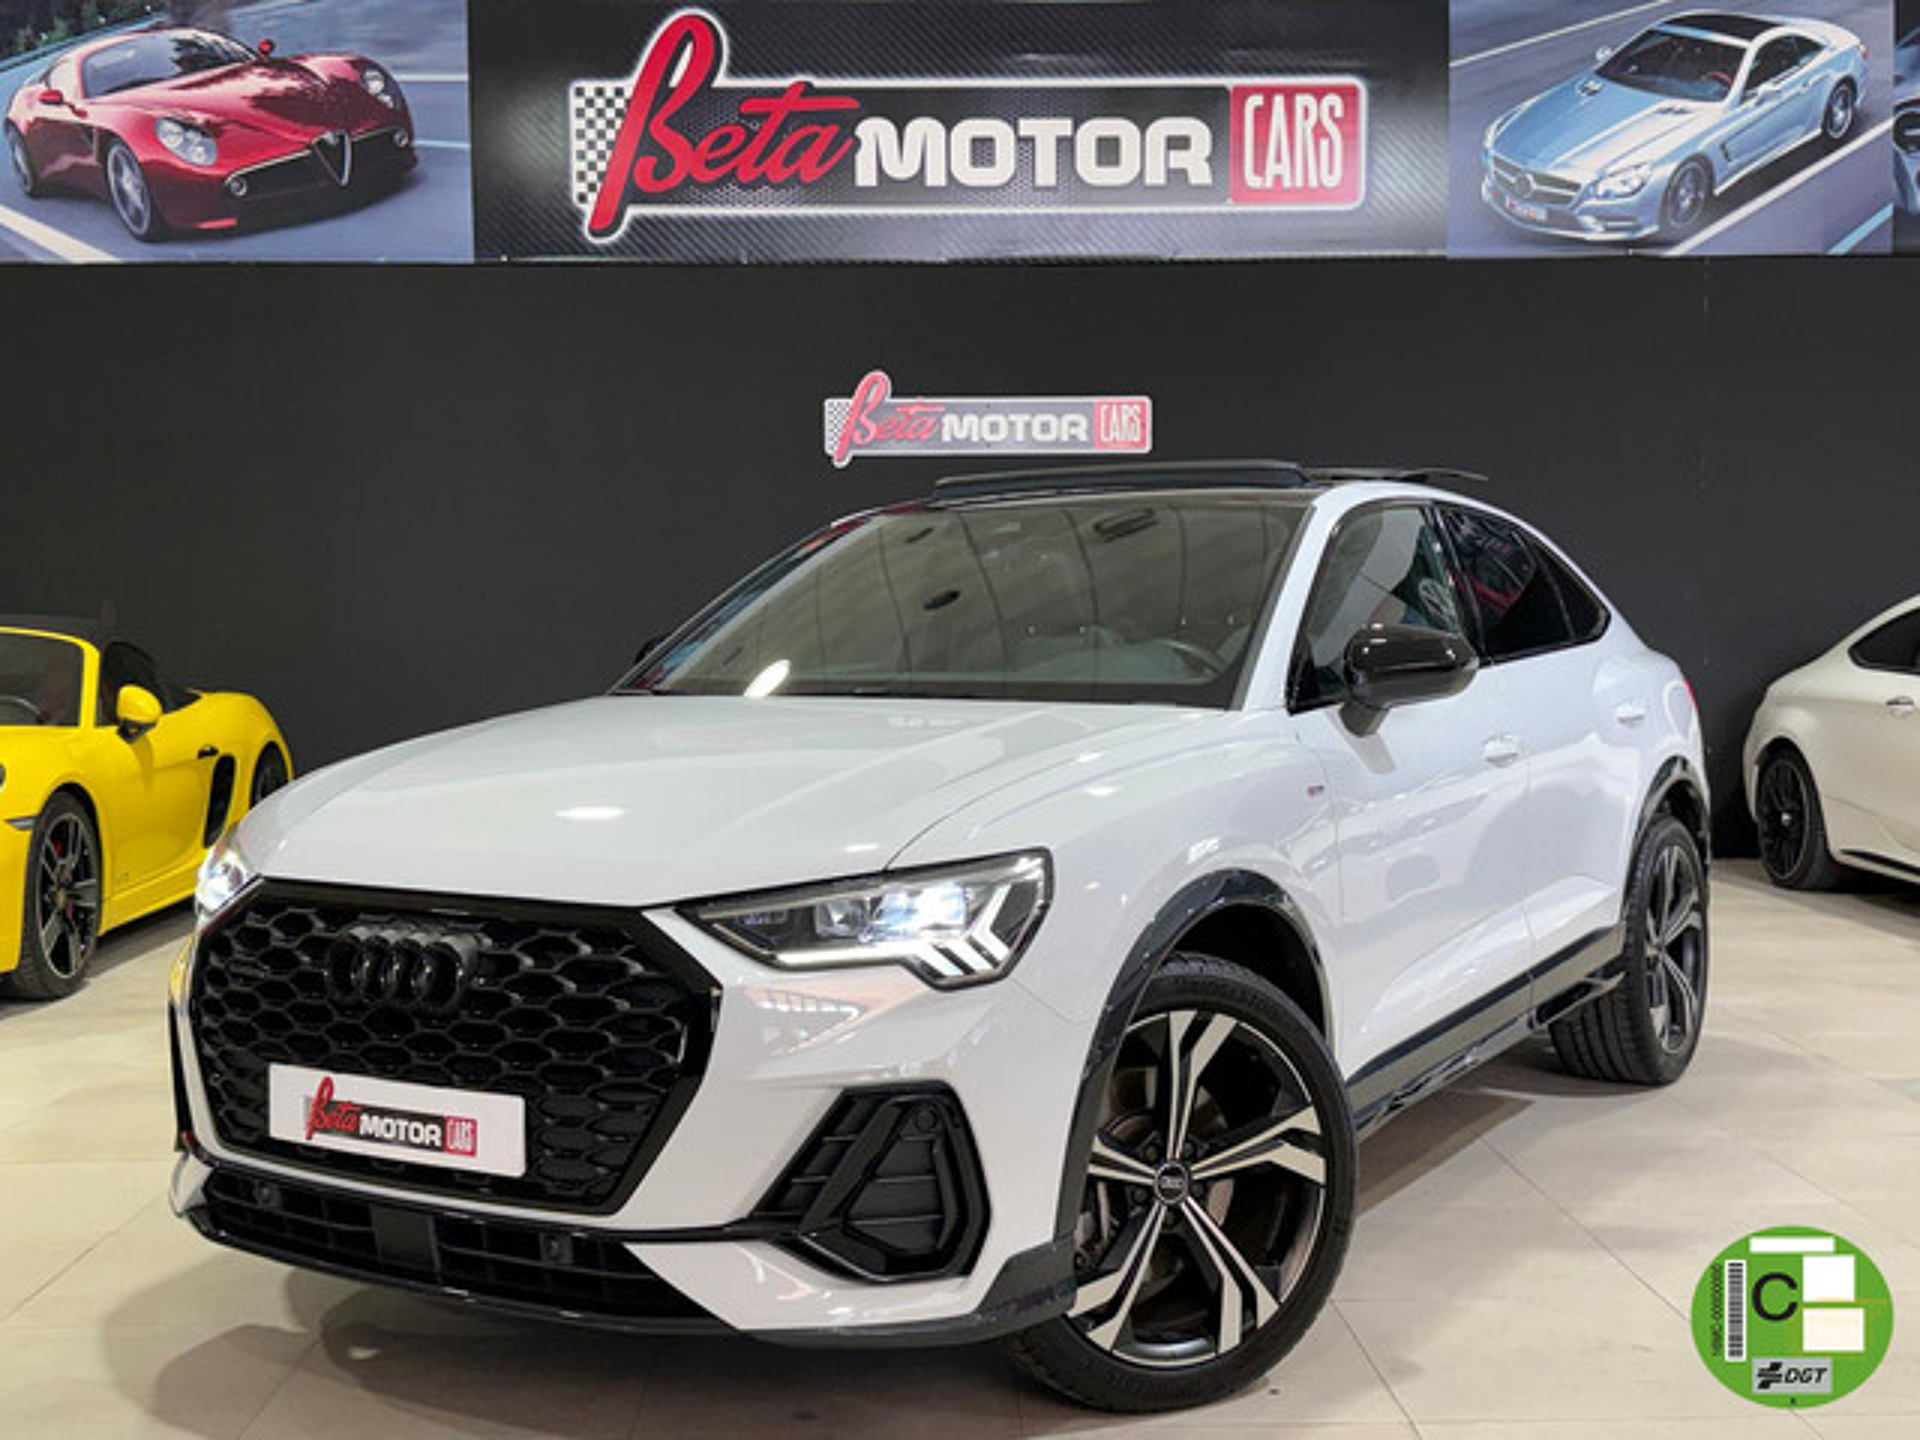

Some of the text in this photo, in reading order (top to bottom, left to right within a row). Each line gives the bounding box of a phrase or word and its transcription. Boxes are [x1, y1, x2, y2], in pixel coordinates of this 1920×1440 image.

[856, 117, 1213, 188] MOTOR
[1243, 94, 1345, 190] CARS
[941, 414, 1089, 442] MOTOR
[1101, 404, 1141, 443] CARS
[359, 1113, 442, 1147] MOTOR
[448, 1120, 473, 1151] CARS
